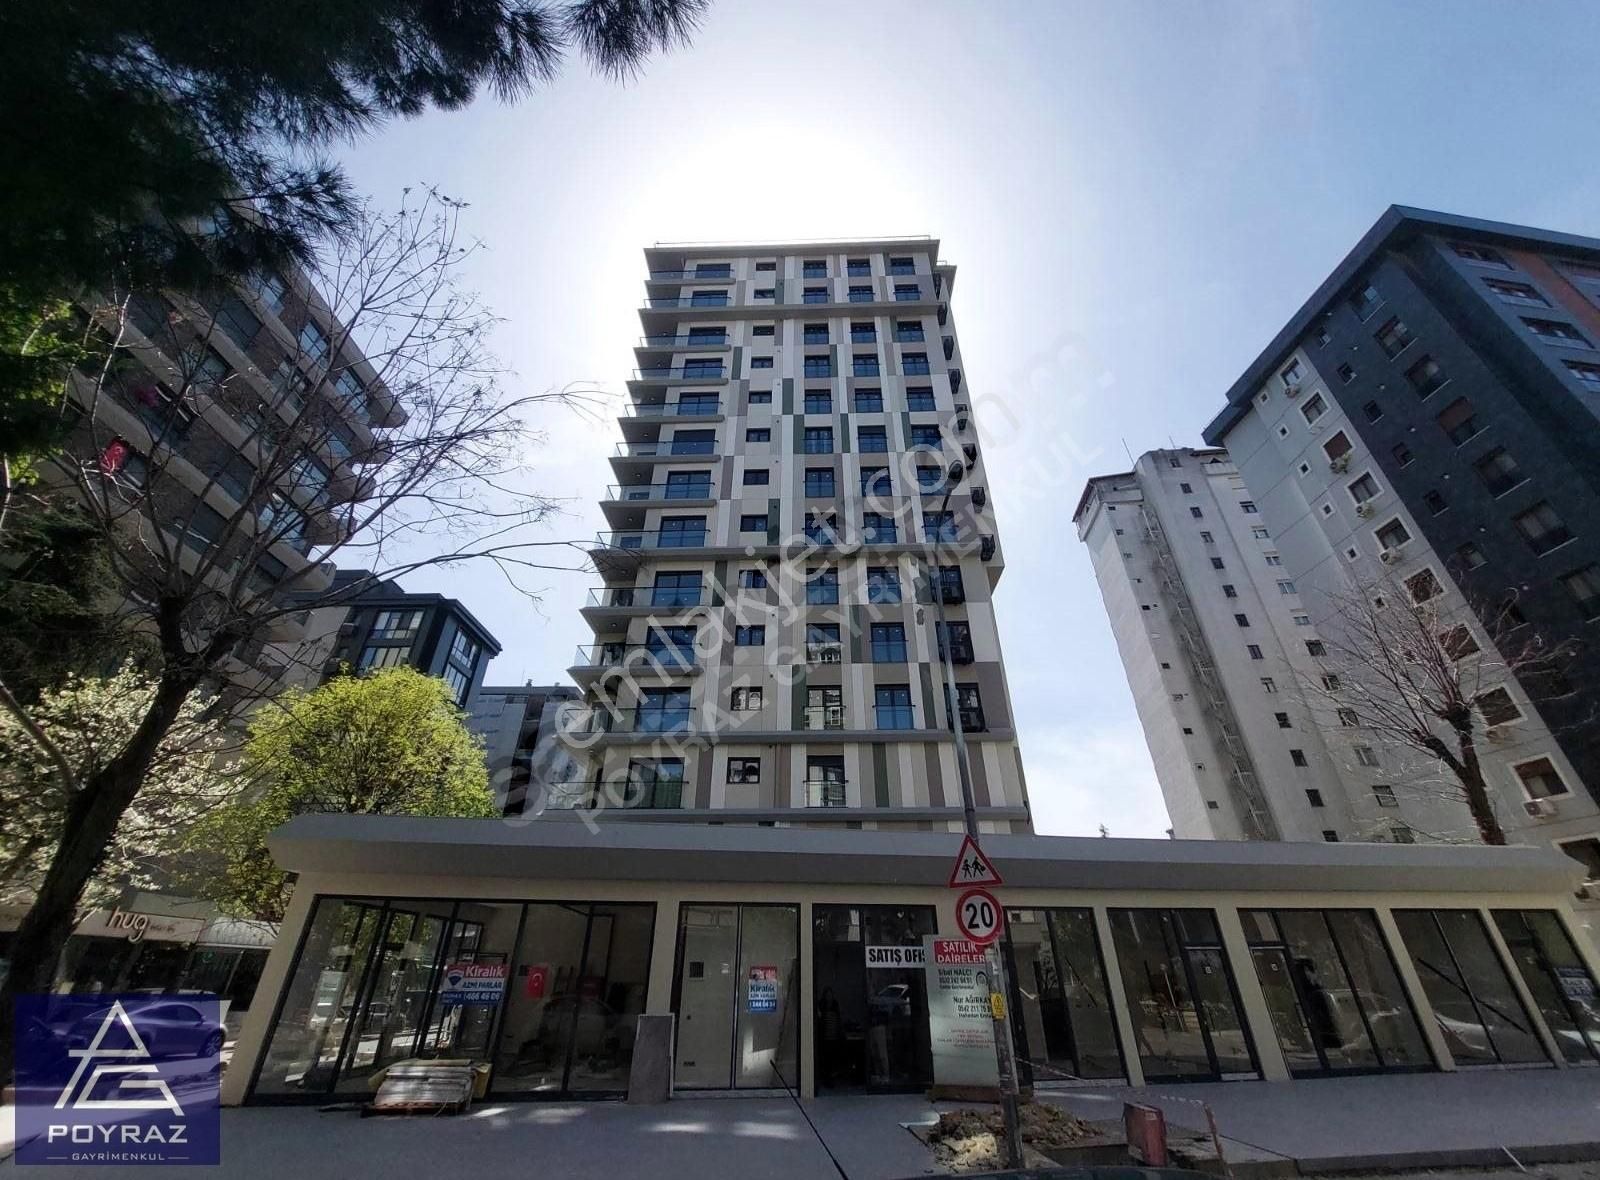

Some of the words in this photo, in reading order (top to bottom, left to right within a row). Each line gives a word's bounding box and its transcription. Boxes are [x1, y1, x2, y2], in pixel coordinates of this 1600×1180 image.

[965, 902, 994, 930] 20
[106, 905, 149, 943] hug
[942, 941, 978, 953] SATILIK
[868, 948, 902, 966] SATIŞ
[937, 953, 985, 964] DAİRELER
[464, 965, 504, 977] Kiralık
